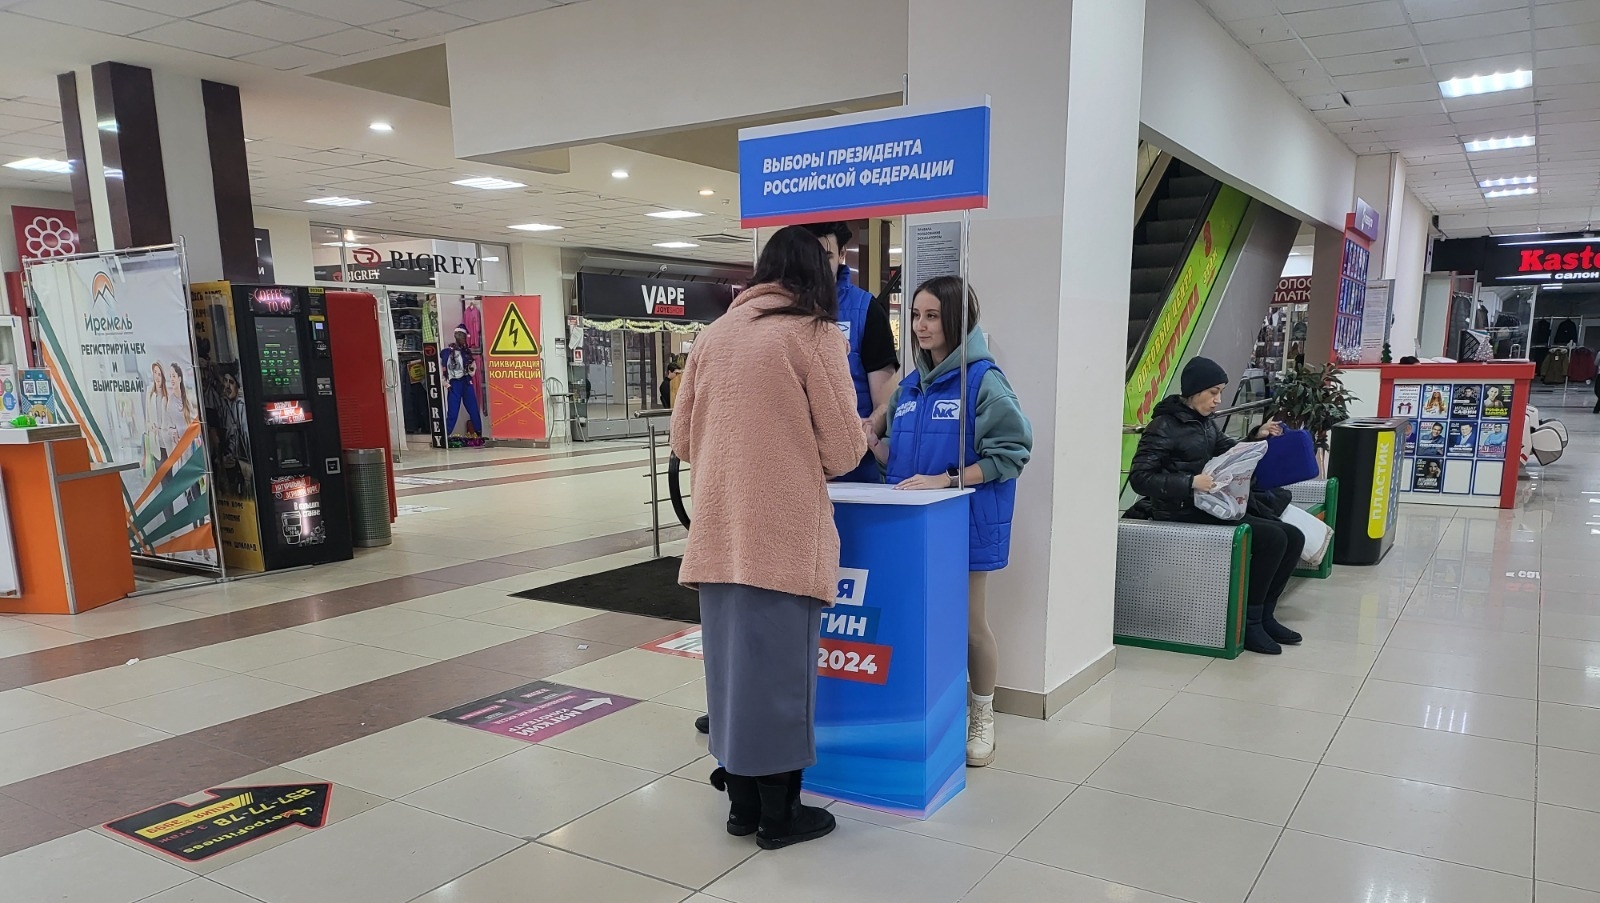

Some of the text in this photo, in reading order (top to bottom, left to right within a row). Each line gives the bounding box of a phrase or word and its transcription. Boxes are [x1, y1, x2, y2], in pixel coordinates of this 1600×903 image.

[762, 139, 923, 174] ВЫБОРЫ ПРЕЗИДЕНТА
[763, 159, 955, 196] РОССИЙСКОЙ ФЕДЕРАЦИИ
[389, 250, 478, 275] BIGREY
[1554, 272, 1600, 280] салон
[641, 284, 685, 315] VAPE
[1274, 290, 1310, 302] ПЛАТК
[267, 301, 279, 313] TO
[81, 340, 146, 355] РЕГИСТРИРУЙ ЧЕК
[112, 361, 118, 373] И
[489, 360, 540, 369] ЛИКВИДАЦИЯ
[489, 368, 541, 379] КОЛЛЕКЦИЙ
[93, 377, 144, 392] ВЫИГРЫВАЙ!
[1372, 442, 1390, 520] ПЛАСТИК
[819, 612, 867, 637] ТИН
[817, 647, 878, 675] 2024
[515, 710, 583, 737] МЯГКИЙ
[193, 802, 235, 819] АКЦИЯ
[212, 788, 316, 827] 257-77-78
